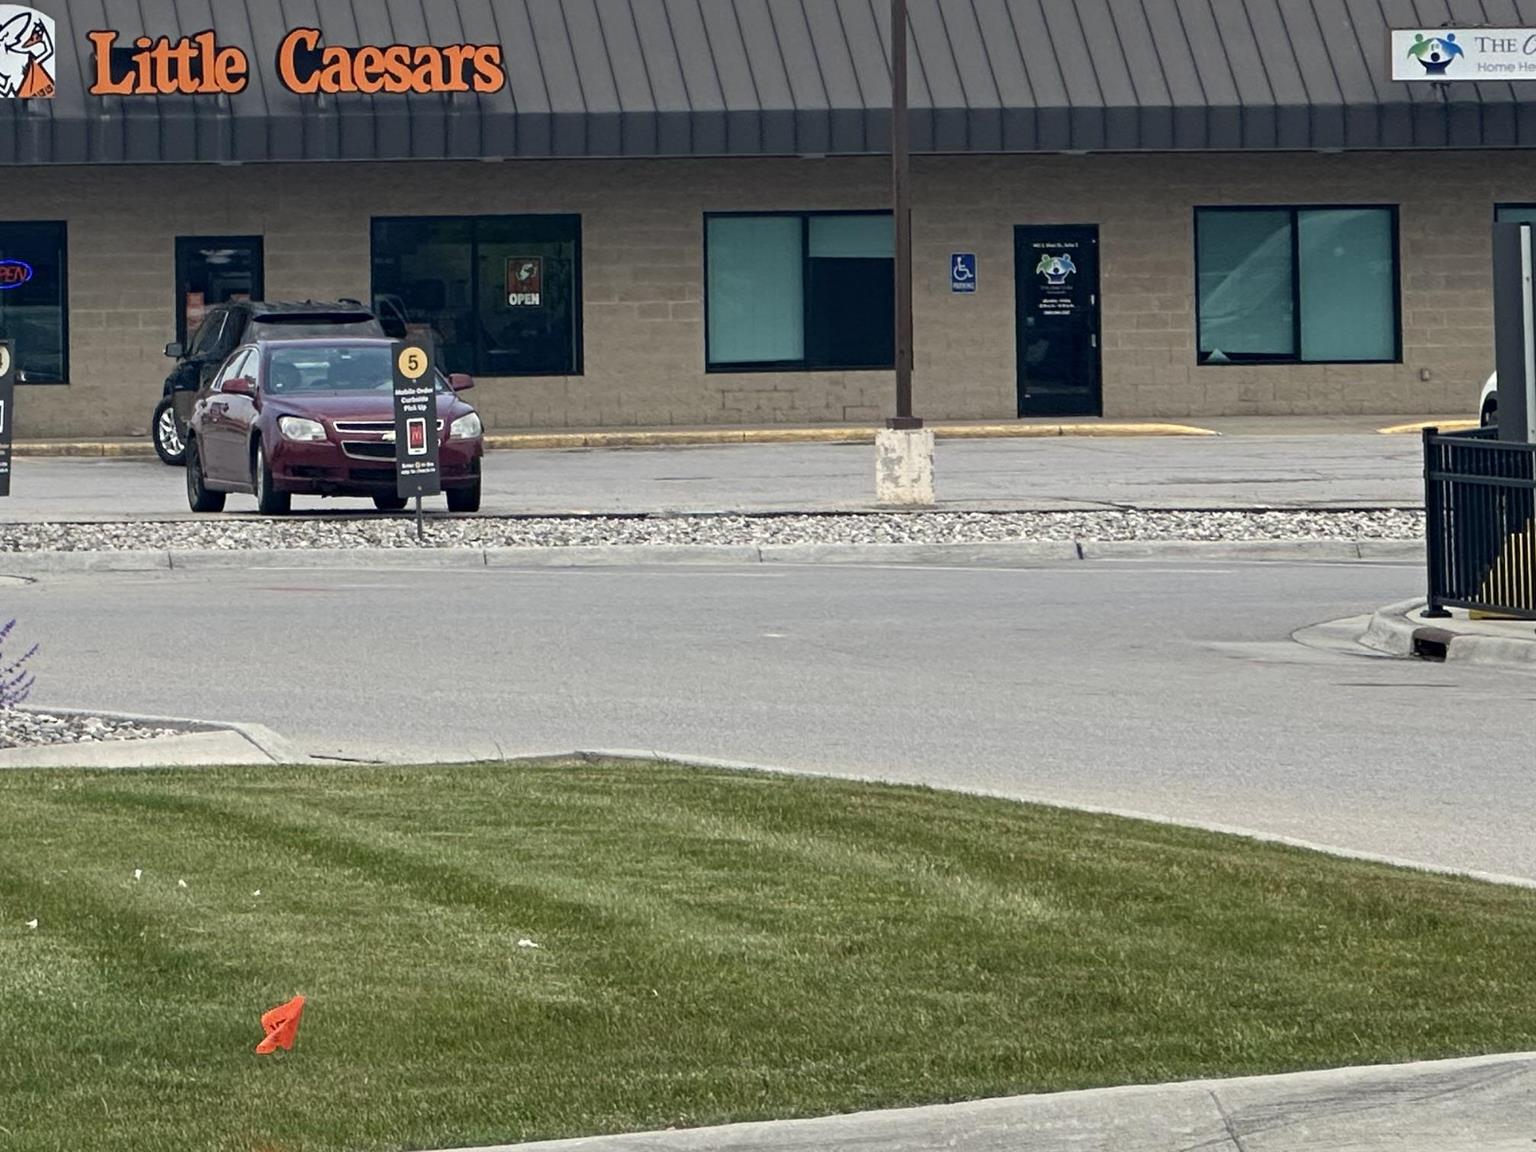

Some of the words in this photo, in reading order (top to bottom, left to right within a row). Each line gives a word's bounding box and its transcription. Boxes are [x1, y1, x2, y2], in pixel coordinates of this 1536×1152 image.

[1474, 36, 1518, 53] THE
[88, 29, 249, 96] Little
[277, 28, 506, 95] Caesars
[1477, 61, 1516, 73] Home
[508, 292, 540, 306] OPEN
[407, 354, 419, 371] 5
